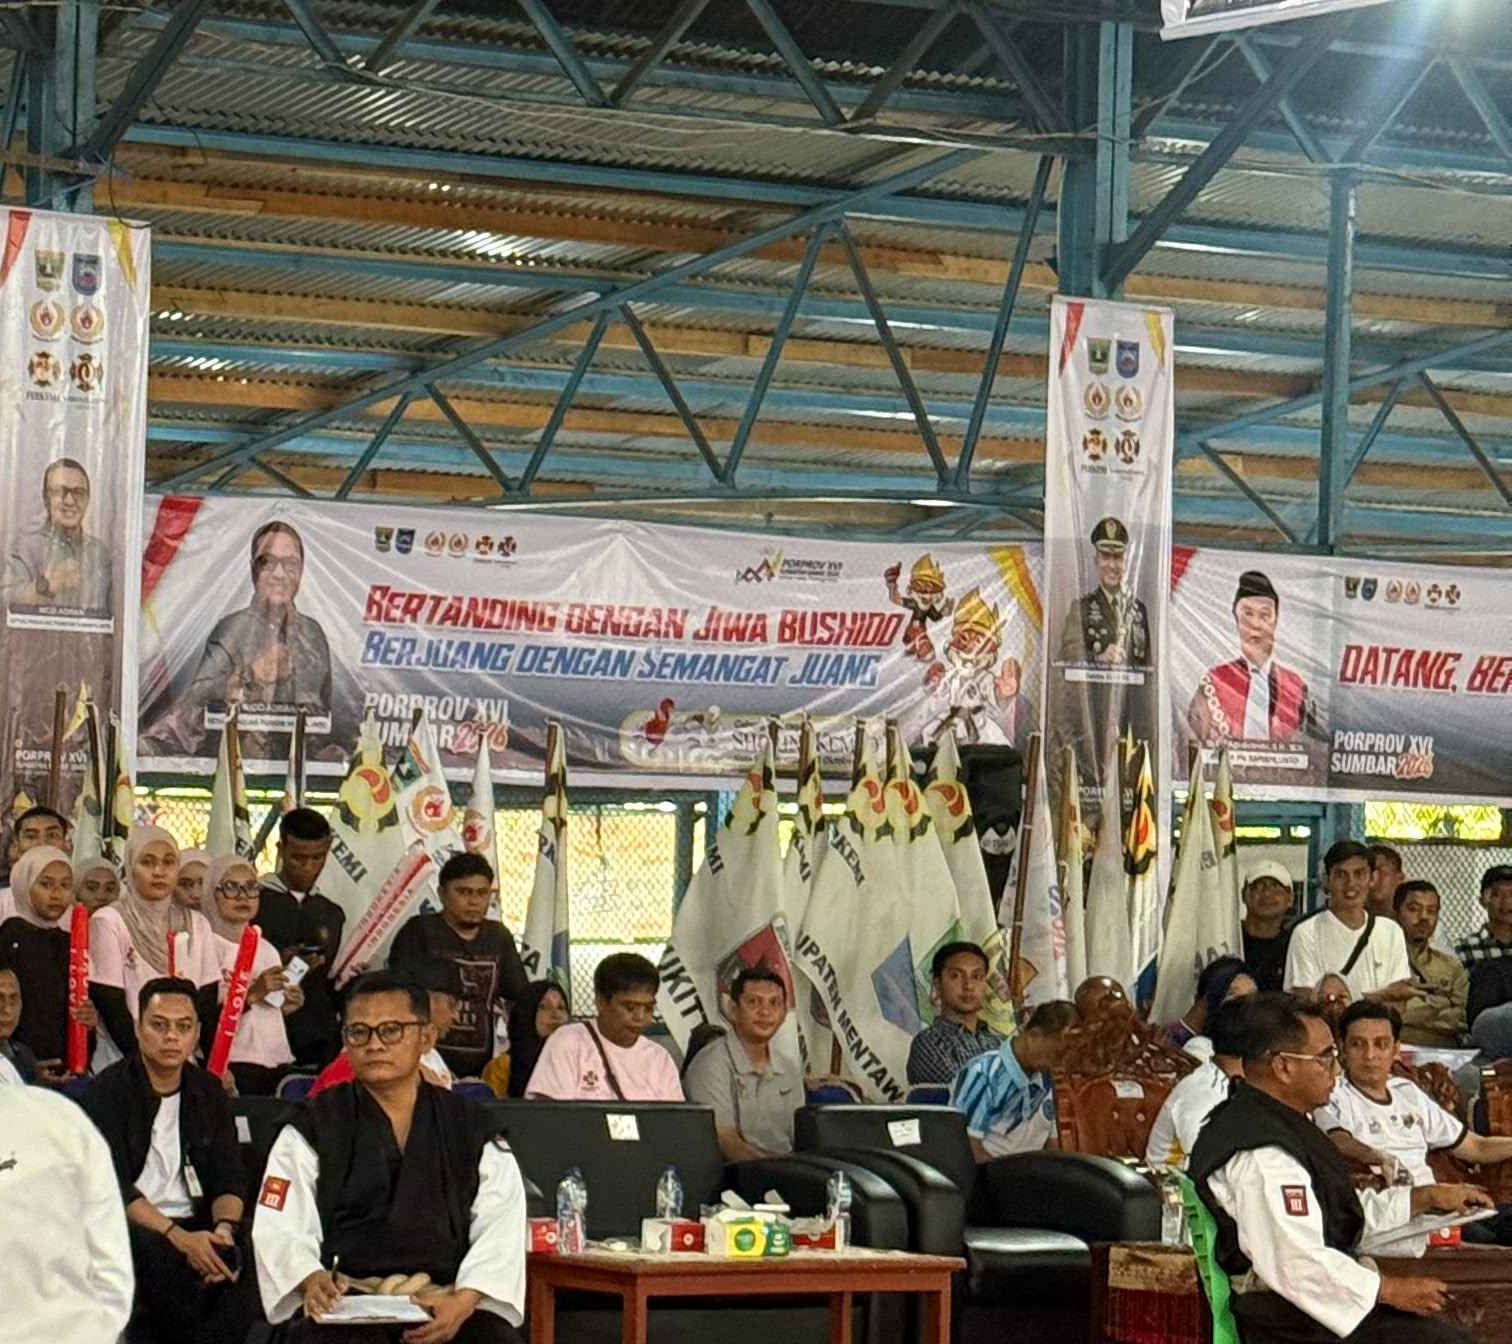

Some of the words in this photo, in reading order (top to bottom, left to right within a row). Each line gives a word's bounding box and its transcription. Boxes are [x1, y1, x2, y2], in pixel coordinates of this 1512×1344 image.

[362, 584, 557, 633] BERTANDING
[564, 602, 688, 641] DENGAN
[692, 606, 768, 644] JIWA
[777, 609, 906, 648] BUSHIDO
[360, 630, 518, 673] BERJUANG
[515, 644, 638, 678] DENGAN
[637, 645, 788, 684] SEMANGAT
[791, 652, 881, 688] JUANG
[1340, 644, 1463, 693] DATANG,
[363, 692, 471, 721] PORPROV
[472, 697, 509, 726] XVI
[15, 749, 66, 761] PORPRV
[1330, 751, 1396, 775] SUMBAR
[1334, 729, 1405, 753] PORPROV
[1409, 735, 1434, 756] XVI
[838, 1008, 905, 1103] MENTAW
